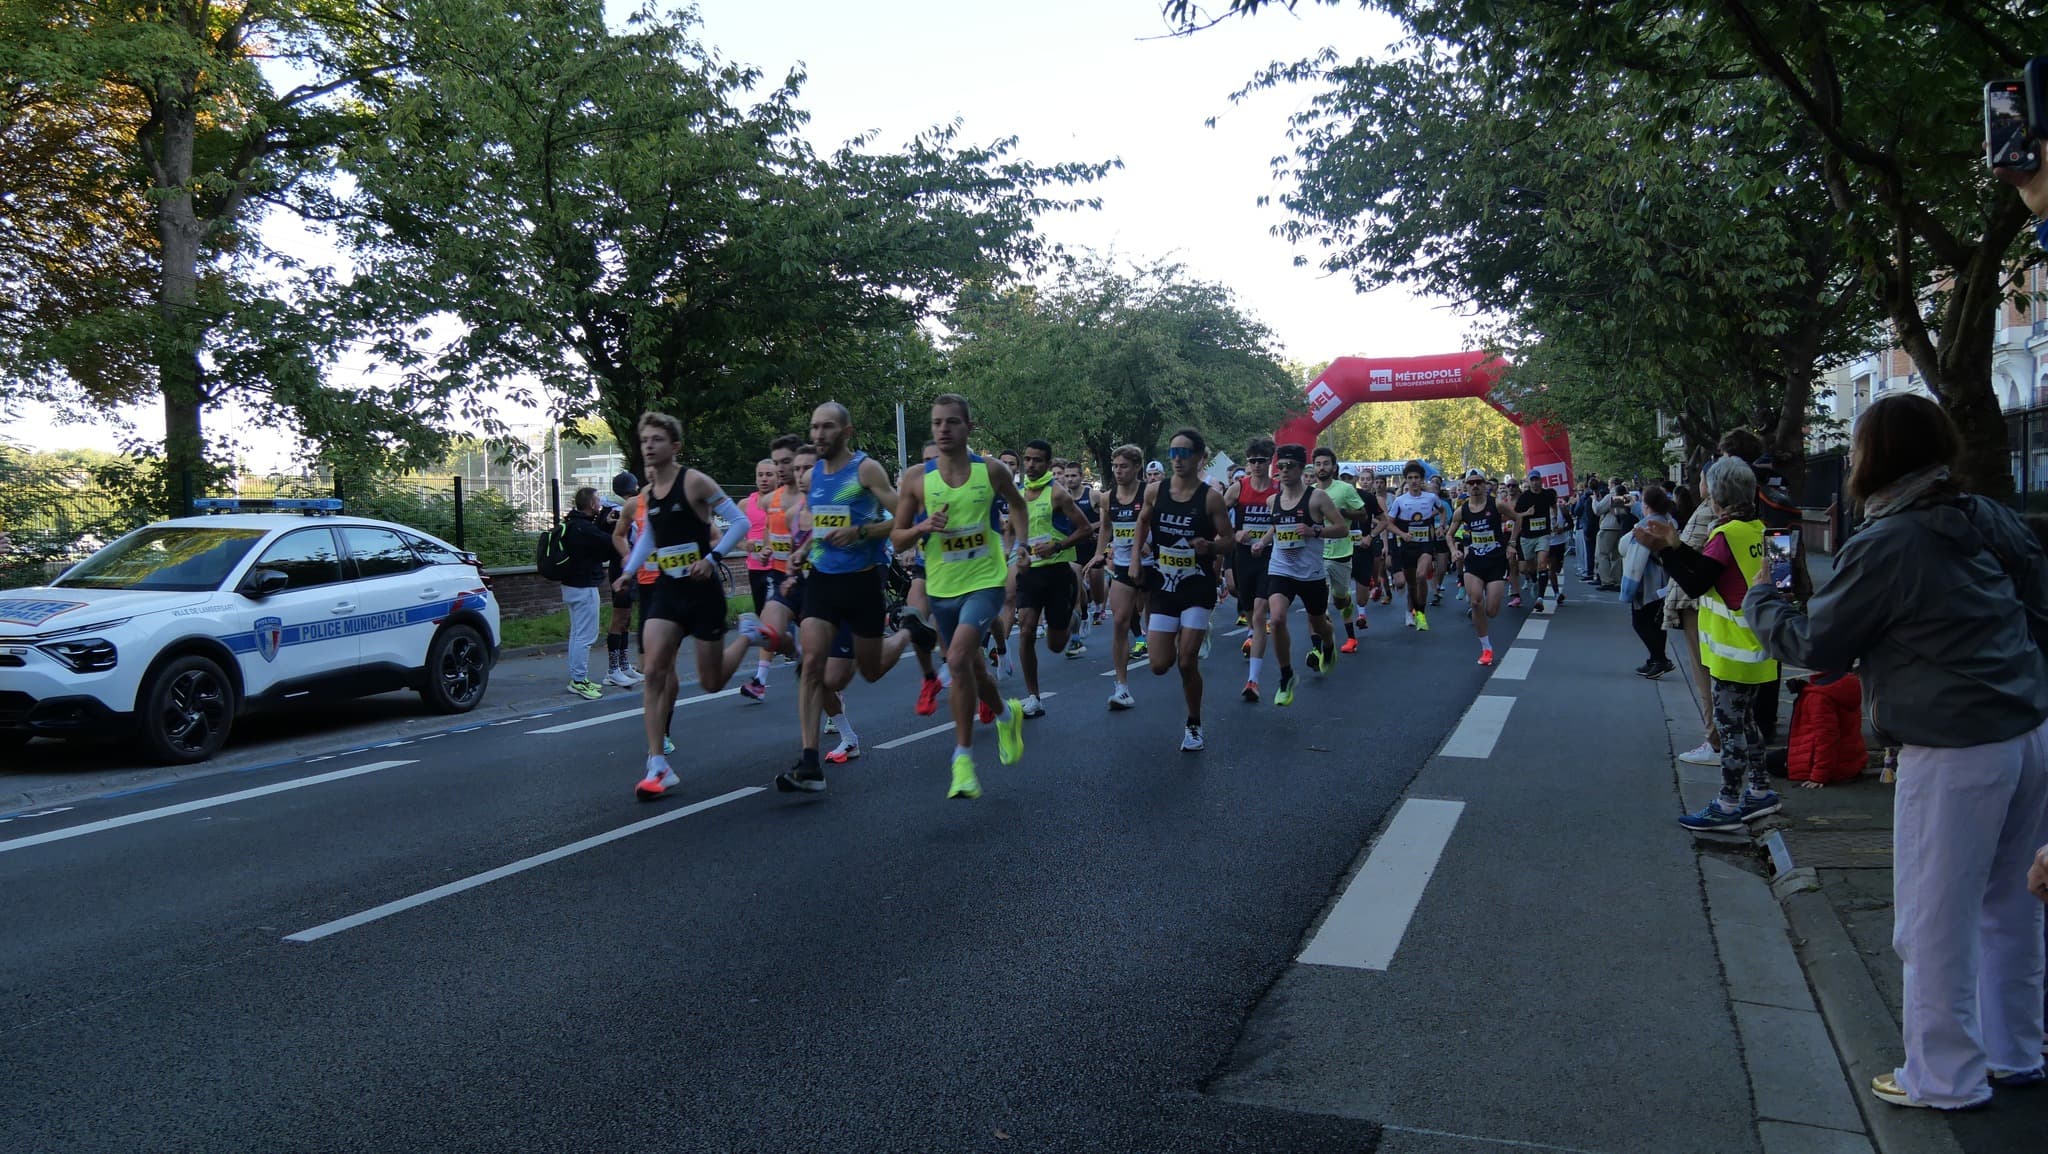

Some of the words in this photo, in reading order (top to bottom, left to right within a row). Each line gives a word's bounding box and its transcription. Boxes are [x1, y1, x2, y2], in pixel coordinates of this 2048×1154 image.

[1395, 368, 1462, 381] MÉTROPOLE
[1395, 379, 1435, 388] EUROPÉENNE
[1436, 378, 1445, 386] DE
[1445, 377, 1462, 385] LILLE
[1354, 464, 1405, 473] NTERSPORT
[814, 515, 847, 527] 1427
[1160, 513, 1193, 527] LILLE
[943, 533, 984, 551] 1419
[662, 552, 698, 569] 1318
[1161, 555, 1193, 567] 1369
[302, 620, 342, 640] POLICE
[343, 611, 404, 634] MUNICIPALE
